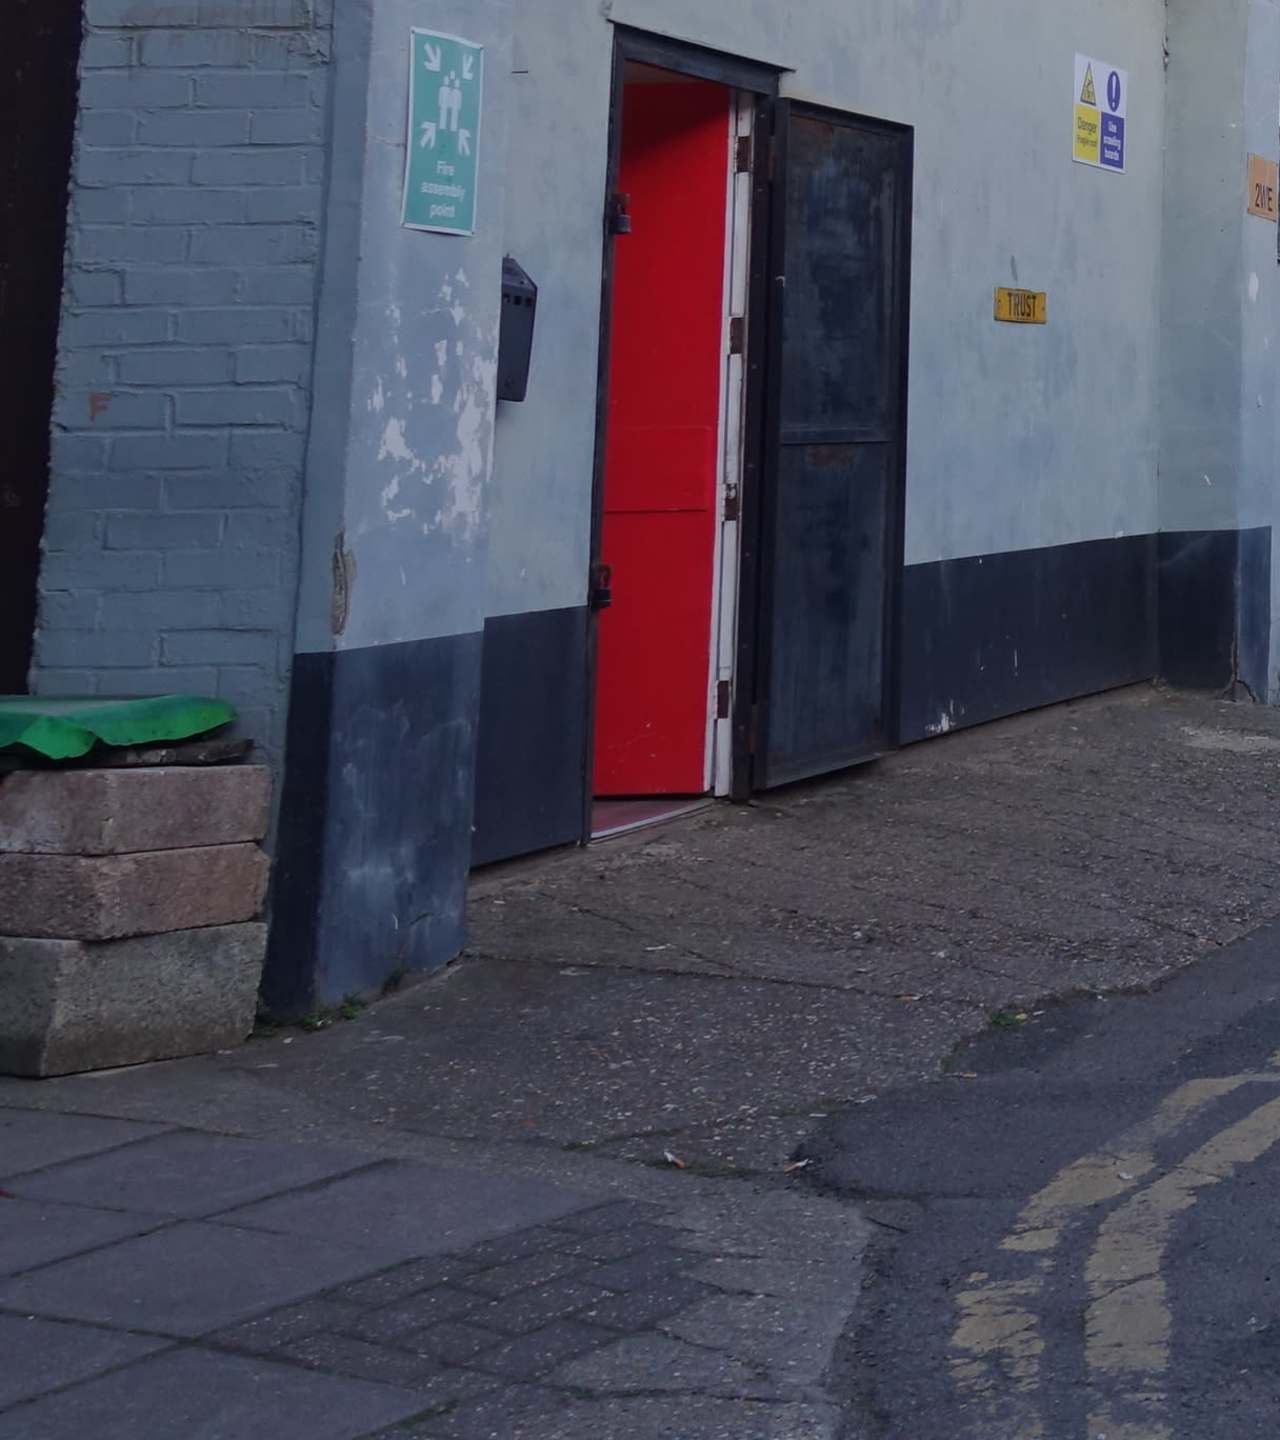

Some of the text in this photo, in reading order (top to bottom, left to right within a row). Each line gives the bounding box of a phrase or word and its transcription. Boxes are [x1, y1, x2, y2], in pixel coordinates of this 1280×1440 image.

[436, 160, 456, 176] Fire
[420, 181, 465, 203] assembly
[429, 203, 456, 219] point
[1007, 292, 1037, 318] TRUST
